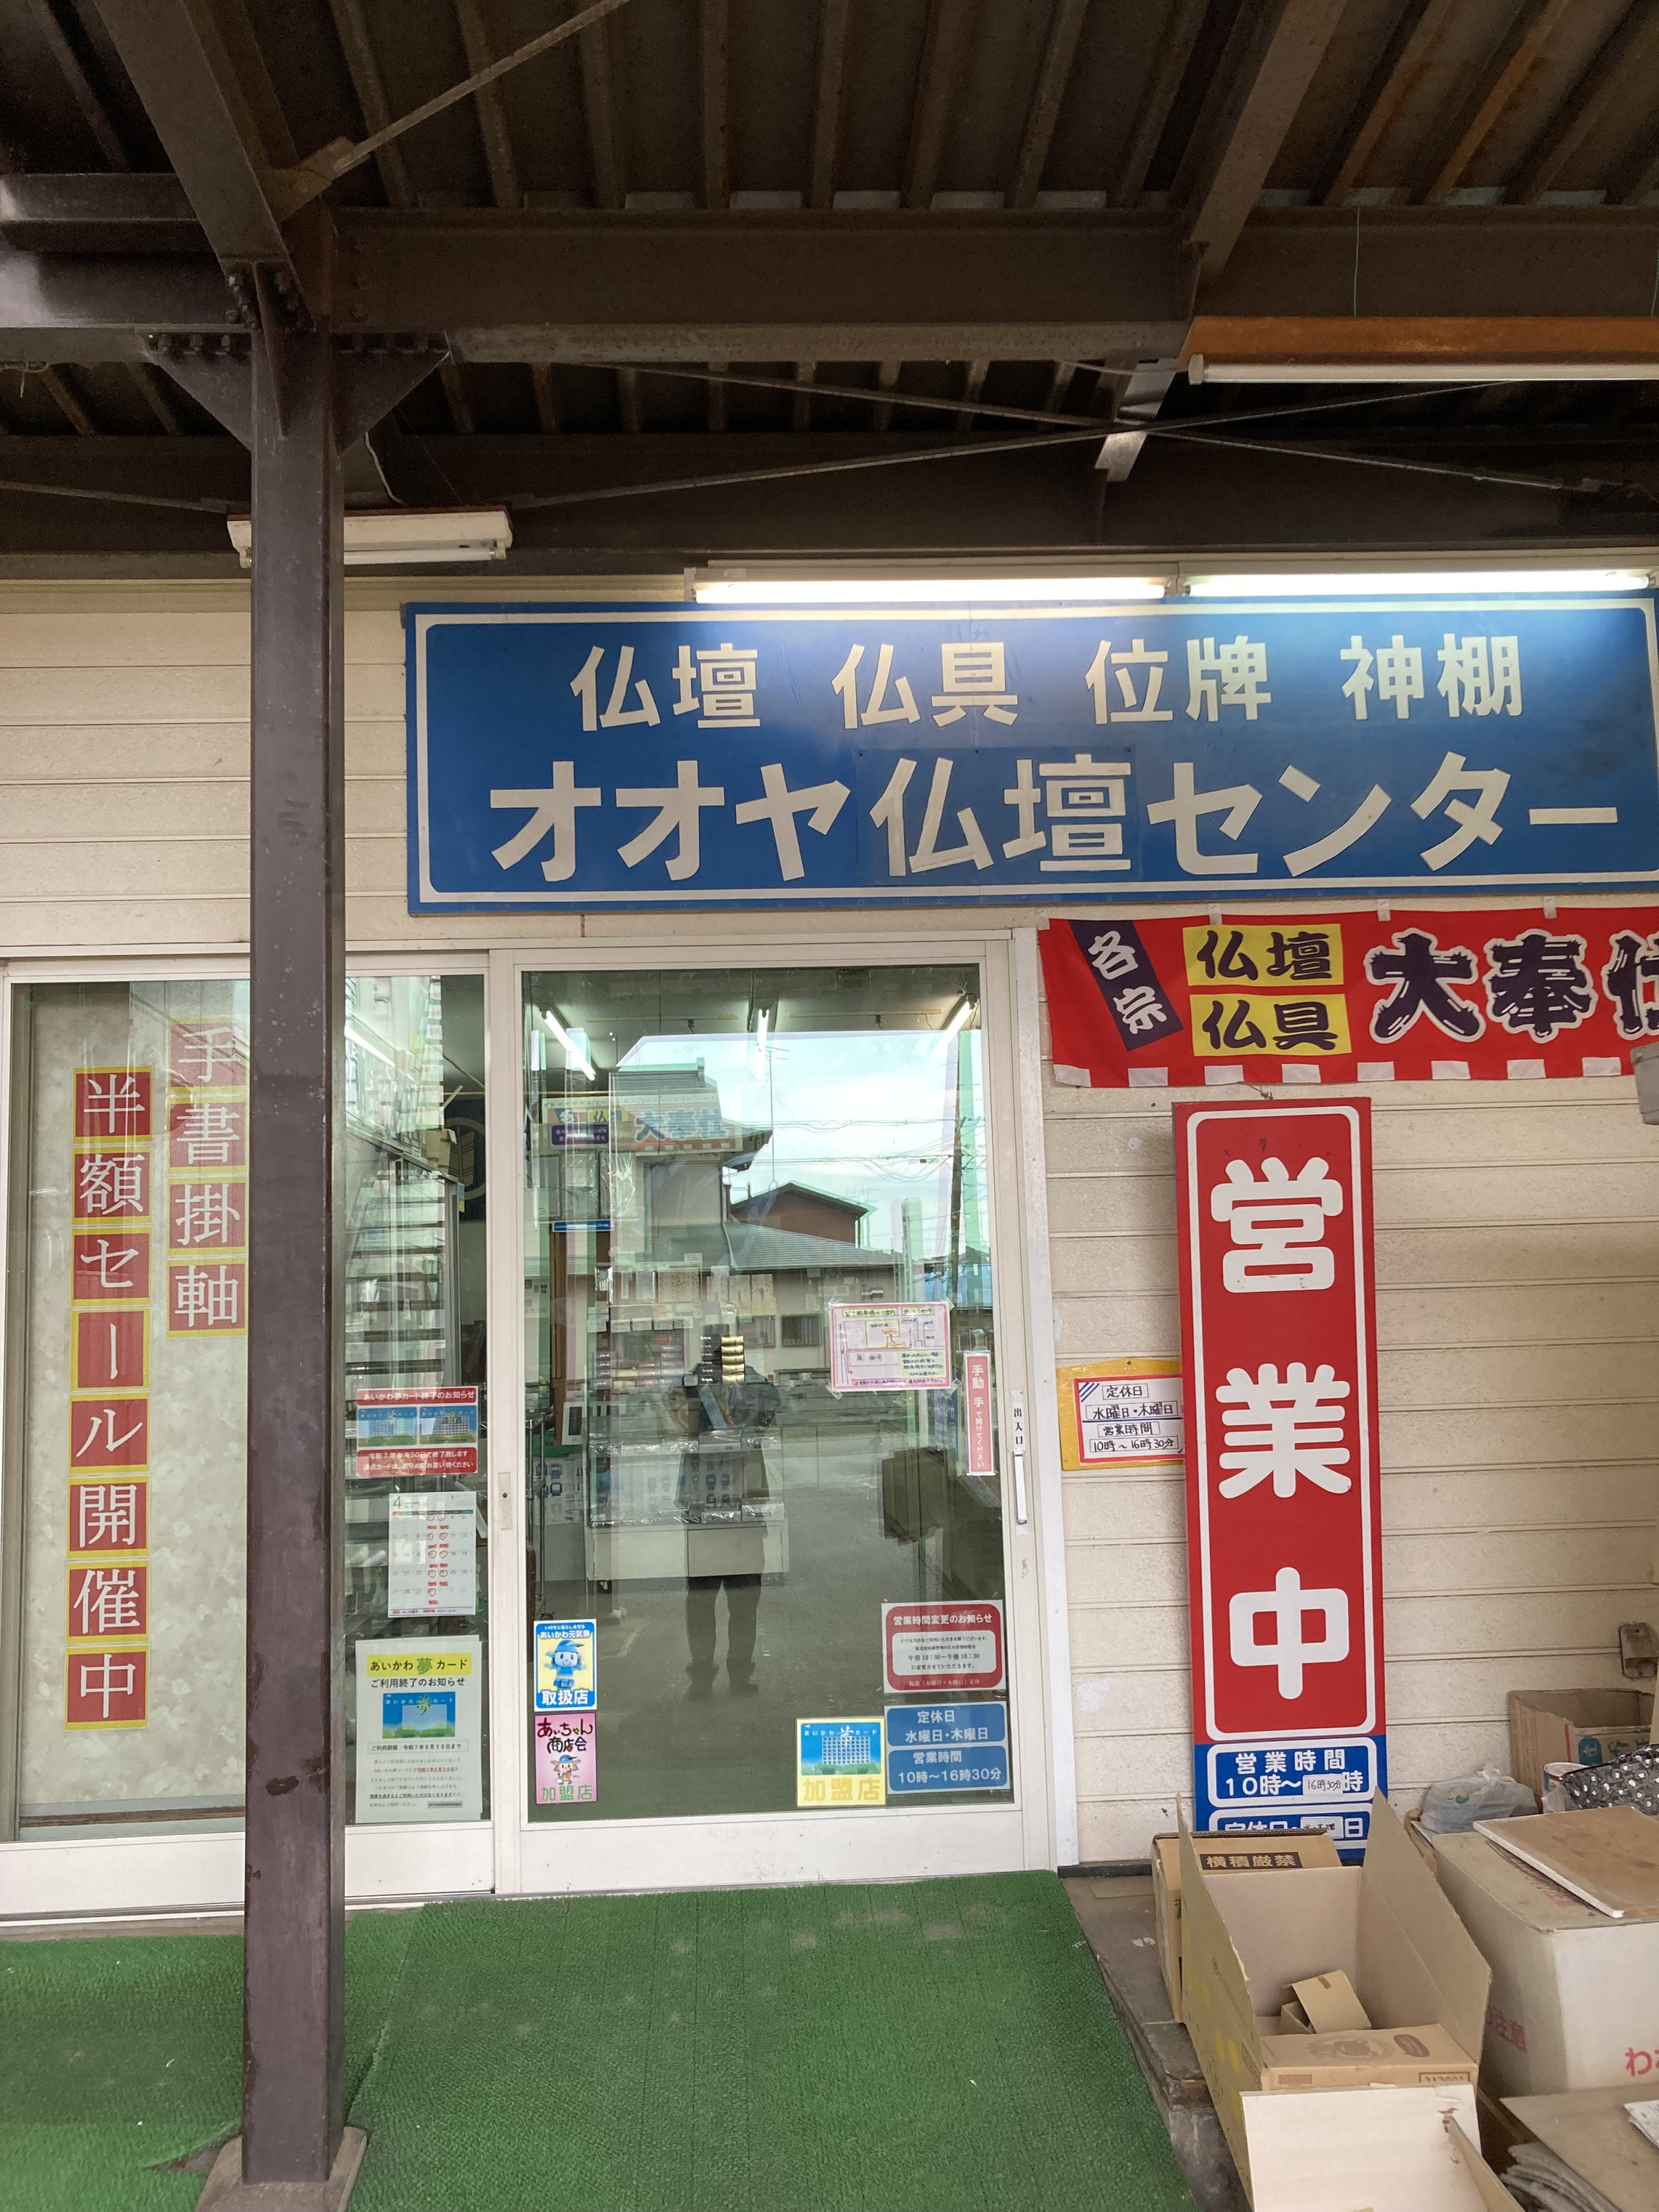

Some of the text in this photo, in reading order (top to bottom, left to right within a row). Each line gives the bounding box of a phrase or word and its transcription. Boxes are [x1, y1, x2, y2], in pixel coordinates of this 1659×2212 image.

[570, 633, 1522, 731] 仏壇 仏具 位牌 神棚
[490, 751, 1618, 882] オオヤ仏壇センター
[1197, 930, 1333, 981] 仏壇
[1087, 930, 1169, 1035] 各宗
[1201, 1000, 1338, 1051] 仏具
[174, 1025, 241, 1327] 手書掛軸
[971, 1365, 984, 1389] 手動
[74, 1074, 145, 1718] 半額セール開催中
[1106, 1385, 1143, 1398] 定休日
[1092, 1402, 1173, 1420] 水曜日・木曜日
[1013, 1407, 1023, 1445] 出入口
[1103, 1422, 1153, 1436] 営業時間
[1210, 1156, 1352, 1700] 営業中
[893, 1614, 992, 1626] 営業時間変更のお知らせ
[371, 1677, 466, 1688] ご利用終了のお知らせ
[541, 1689, 589, 1706] 取扱店
[917, 1710, 955, 1723] 定休日
[537, 1717, 593, 1738] あいちゃん
[905, 1727, 988, 1743] 水曜日・木曜日
[547, 1736, 588, 1754] 商店会
[912, 1750, 962, 1765] 営業時間
[1235, 1749, 1345, 1774] 営業時間
[898, 1768, 1002, 1783] 10時～16時30分
[541, 1785, 592, 1801] 加盟店
[803, 1777, 880, 1801] 加盟店
[1206, 1854, 1296, 1868] 横積厳禁
[1625, 2047, 1659, 2077] わ
